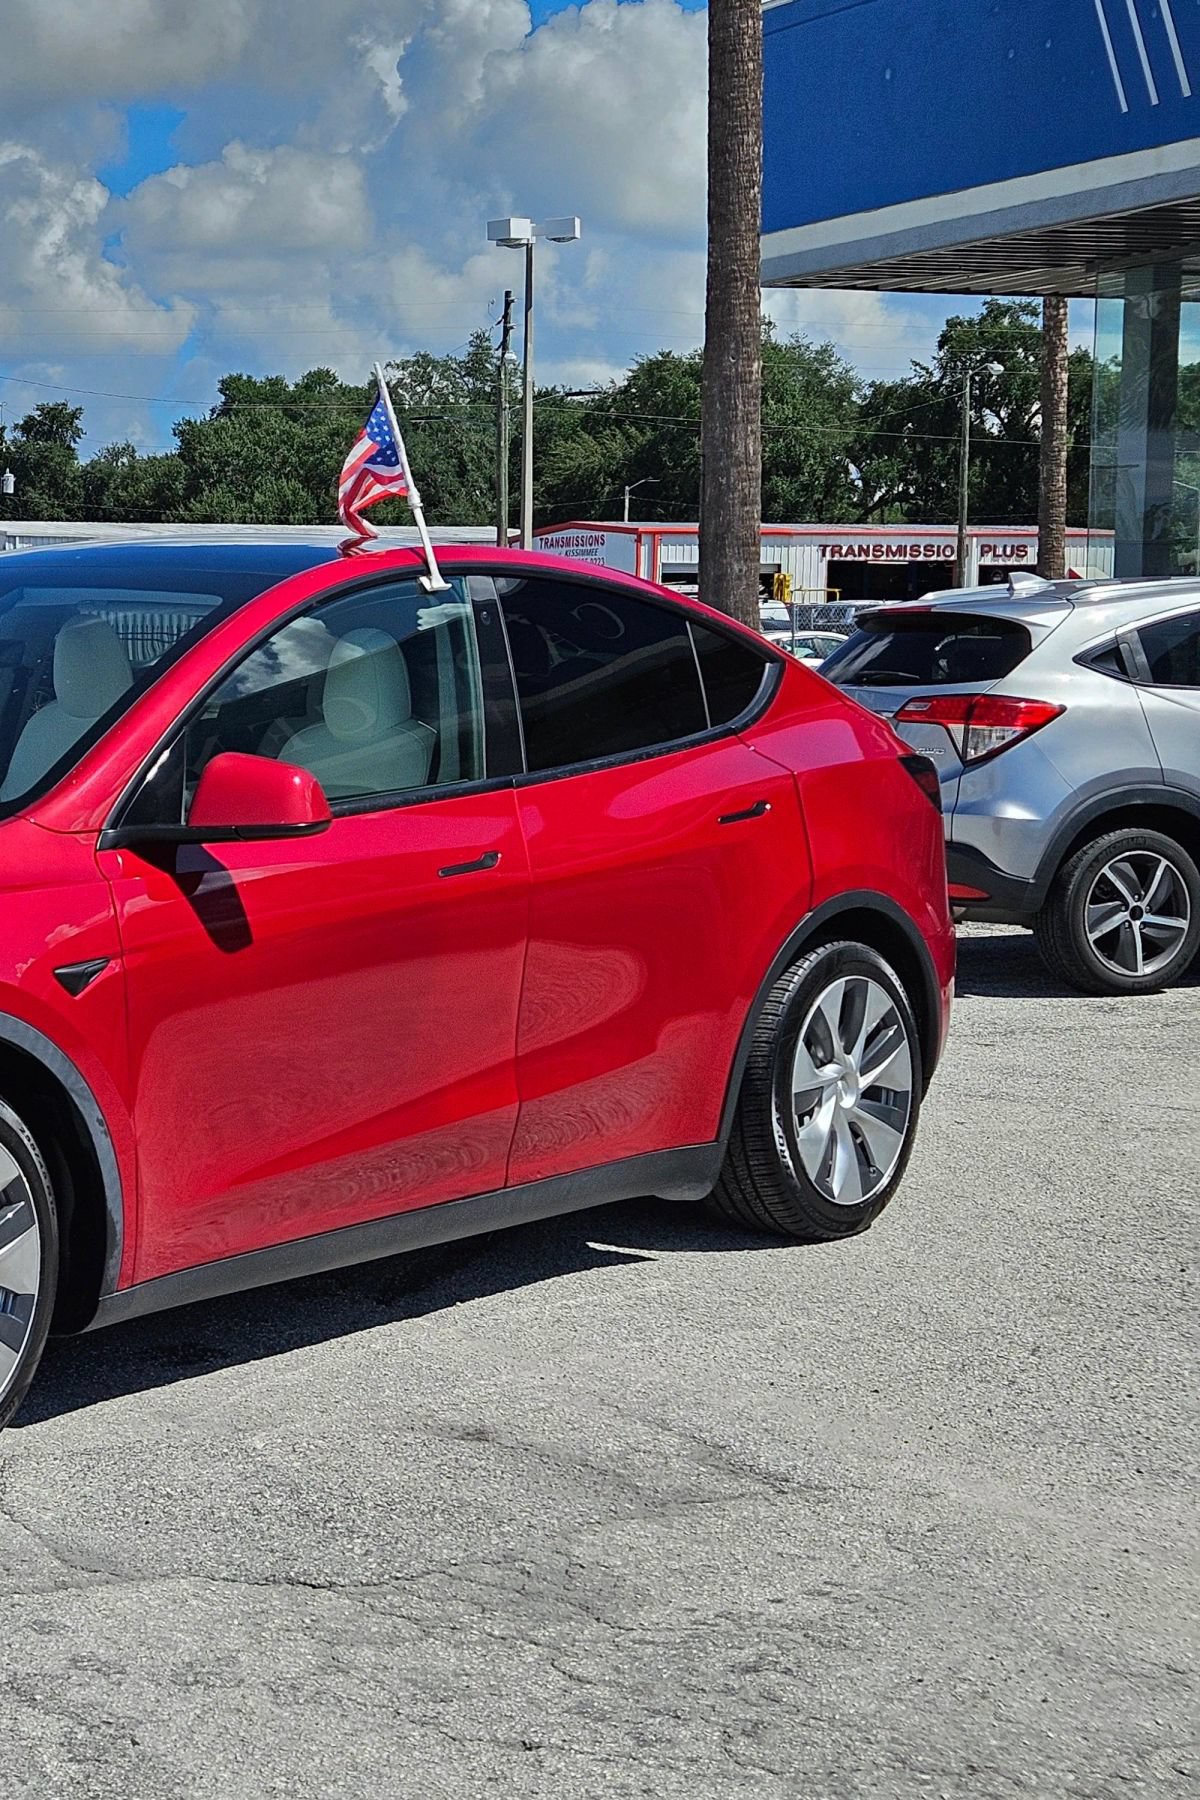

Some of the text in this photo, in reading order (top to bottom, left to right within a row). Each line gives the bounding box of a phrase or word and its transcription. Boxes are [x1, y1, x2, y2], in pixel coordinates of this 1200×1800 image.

[539, 534, 606, 549] TRANSMISSIONS
[818, 543, 1029, 558] TRANSMISSIO PLUS
